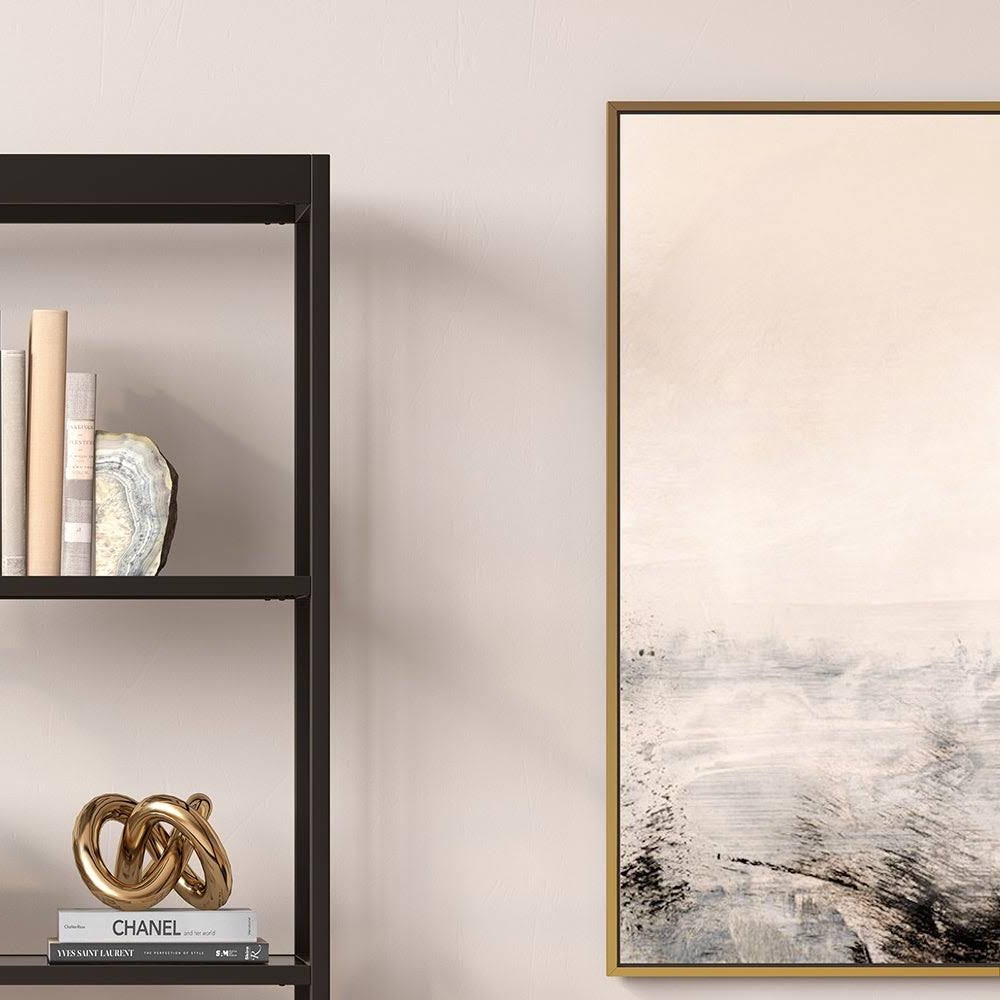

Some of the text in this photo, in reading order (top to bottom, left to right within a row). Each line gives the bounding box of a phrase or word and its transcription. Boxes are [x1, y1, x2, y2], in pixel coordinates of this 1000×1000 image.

[112, 919, 181, 936] CHANEL
[57, 949, 135, 957] YVES SAINT LAURENT
